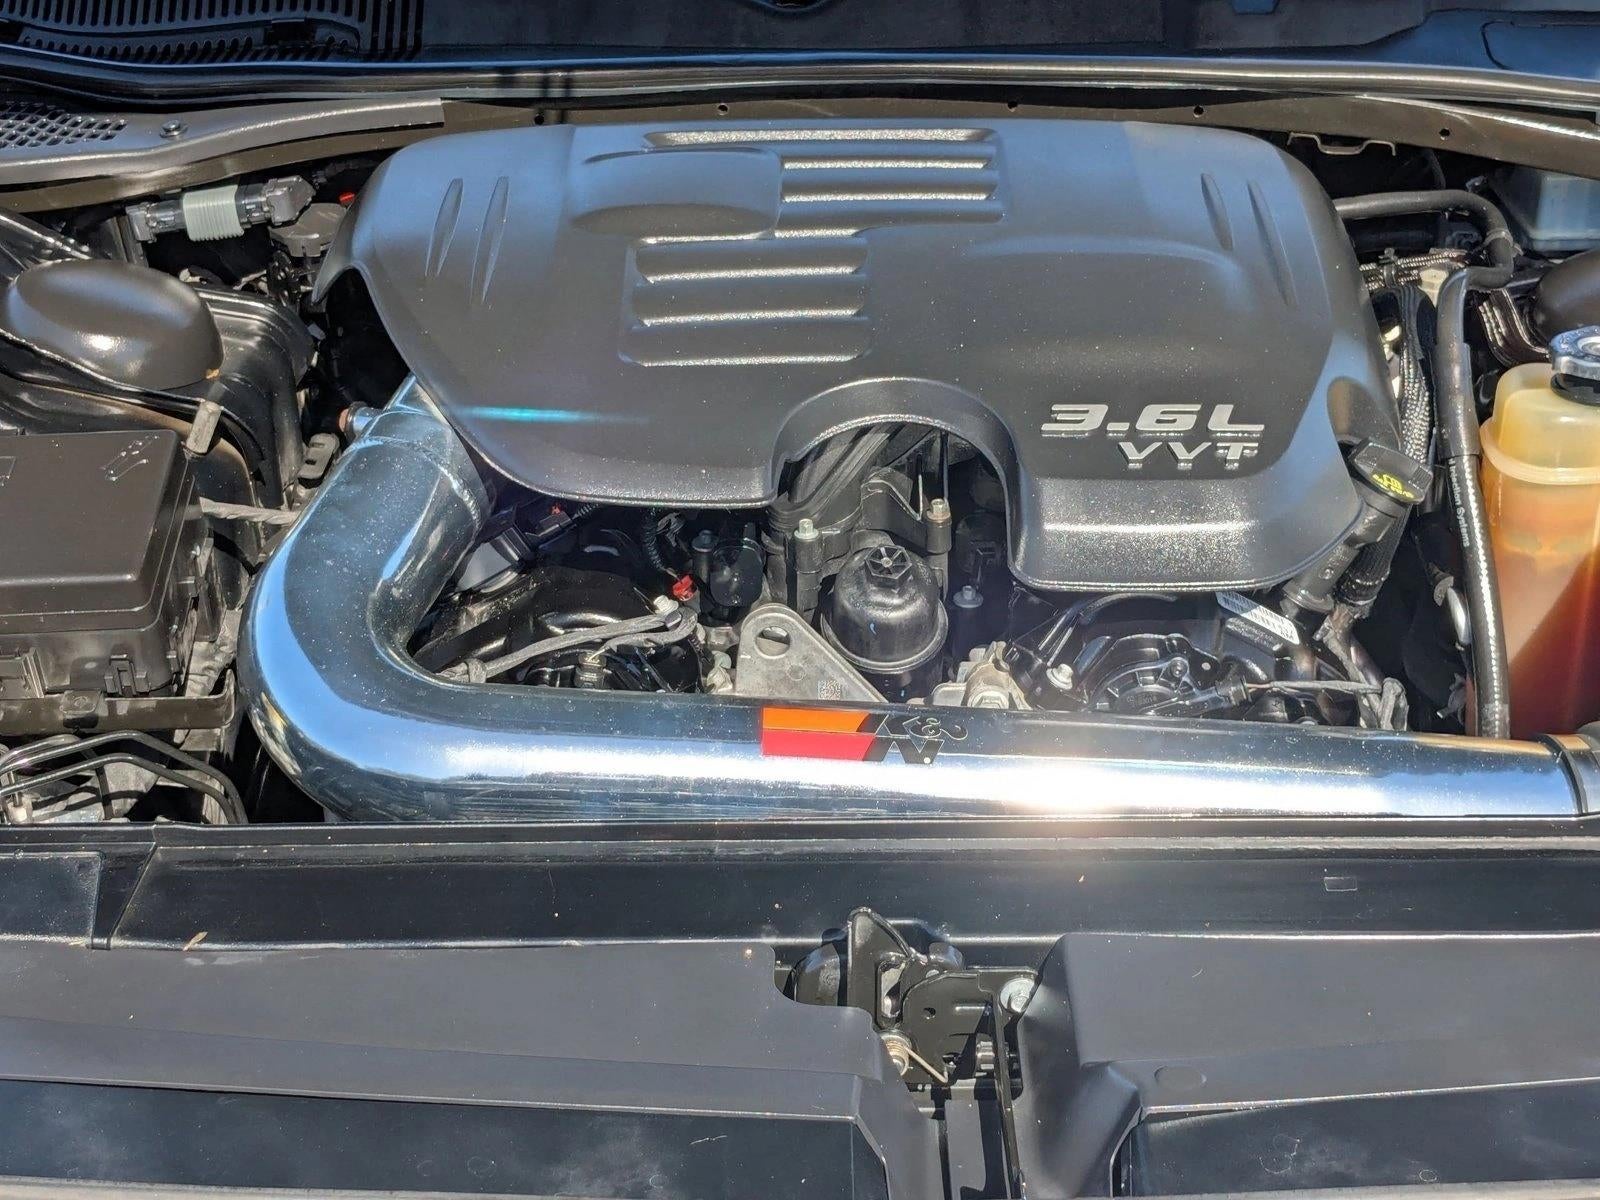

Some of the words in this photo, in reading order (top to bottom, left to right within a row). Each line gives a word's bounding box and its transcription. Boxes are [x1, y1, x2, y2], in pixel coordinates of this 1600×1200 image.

[1041, 404, 1265, 436] 3.6L
[1118, 441, 1259, 468] VVT
[1449, 465, 1462, 506] Injection
[1456, 506, 1470, 548] Systems
